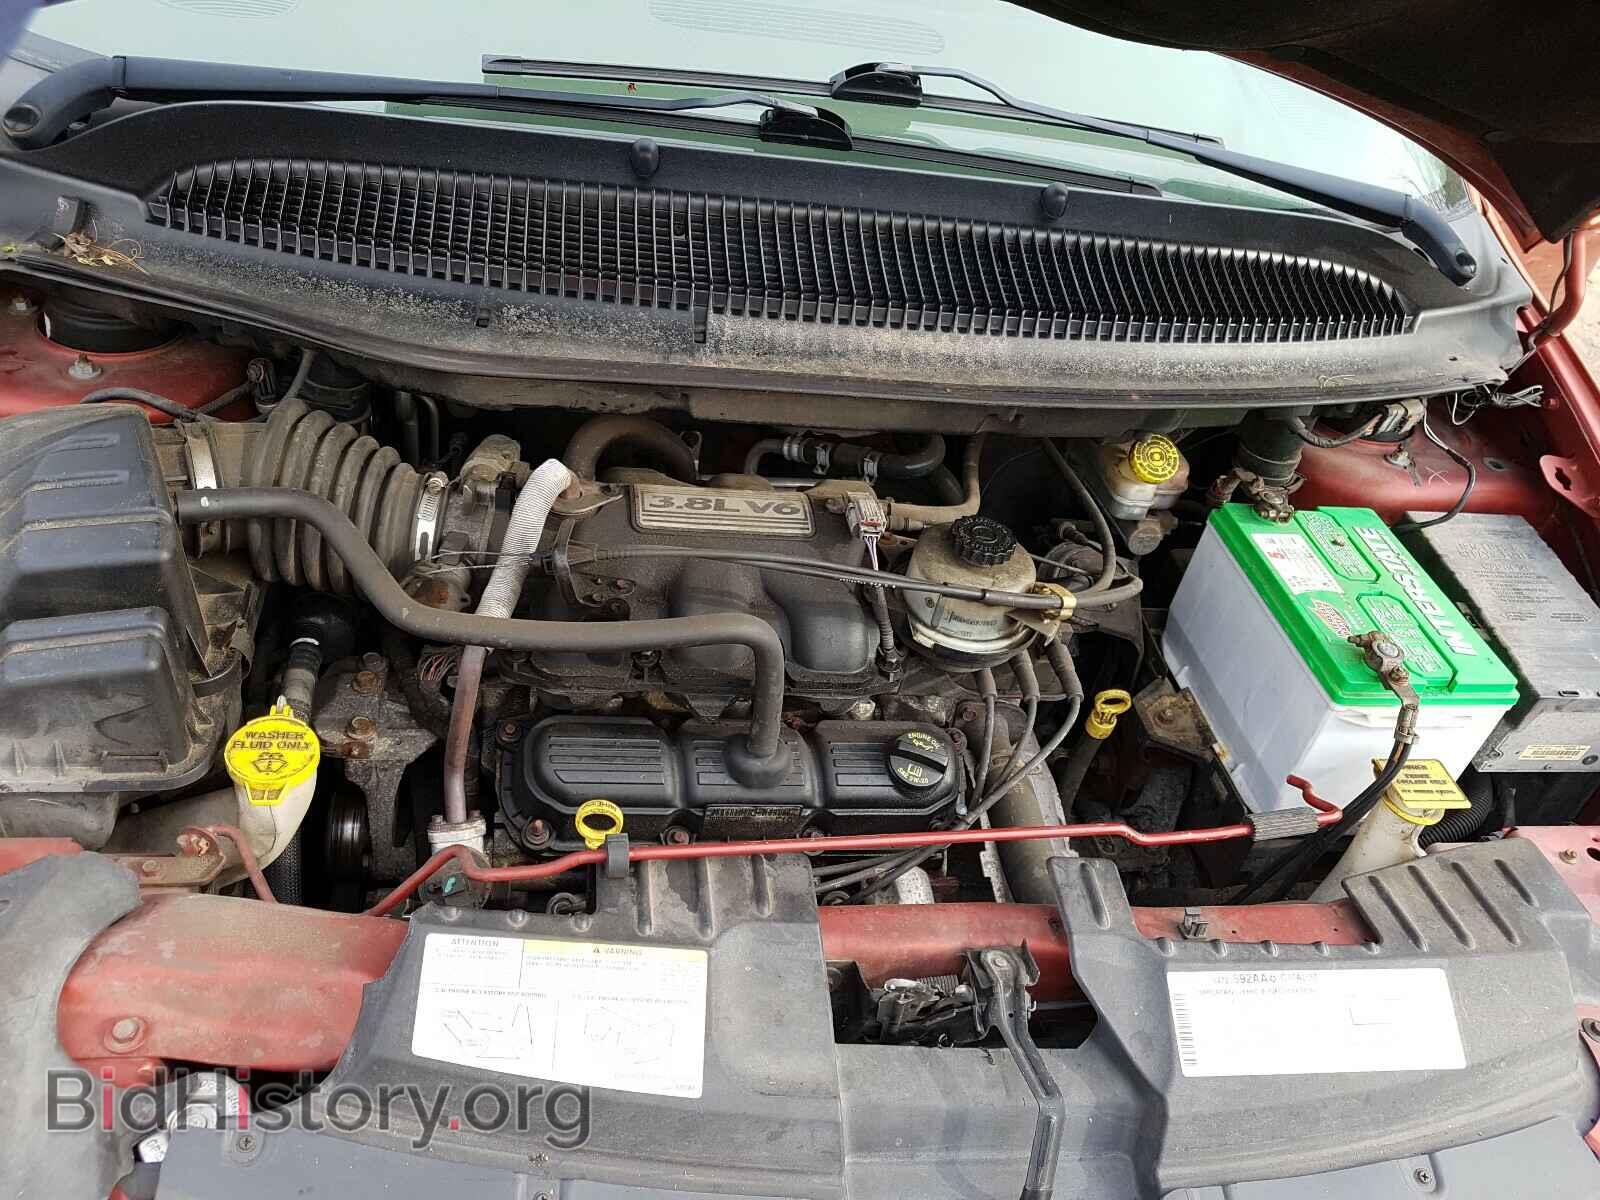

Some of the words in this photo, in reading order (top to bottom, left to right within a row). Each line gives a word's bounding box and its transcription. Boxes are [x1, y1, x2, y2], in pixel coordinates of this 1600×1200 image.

[649, 495, 740, 513] 3.8L
[743, 499, 802, 516] V6
[246, 731, 305, 740] WASHER
[907, 731, 931, 742] ENGINE
[232, 741, 272, 750] FLUID
[277, 741, 310, 750] ONLY
